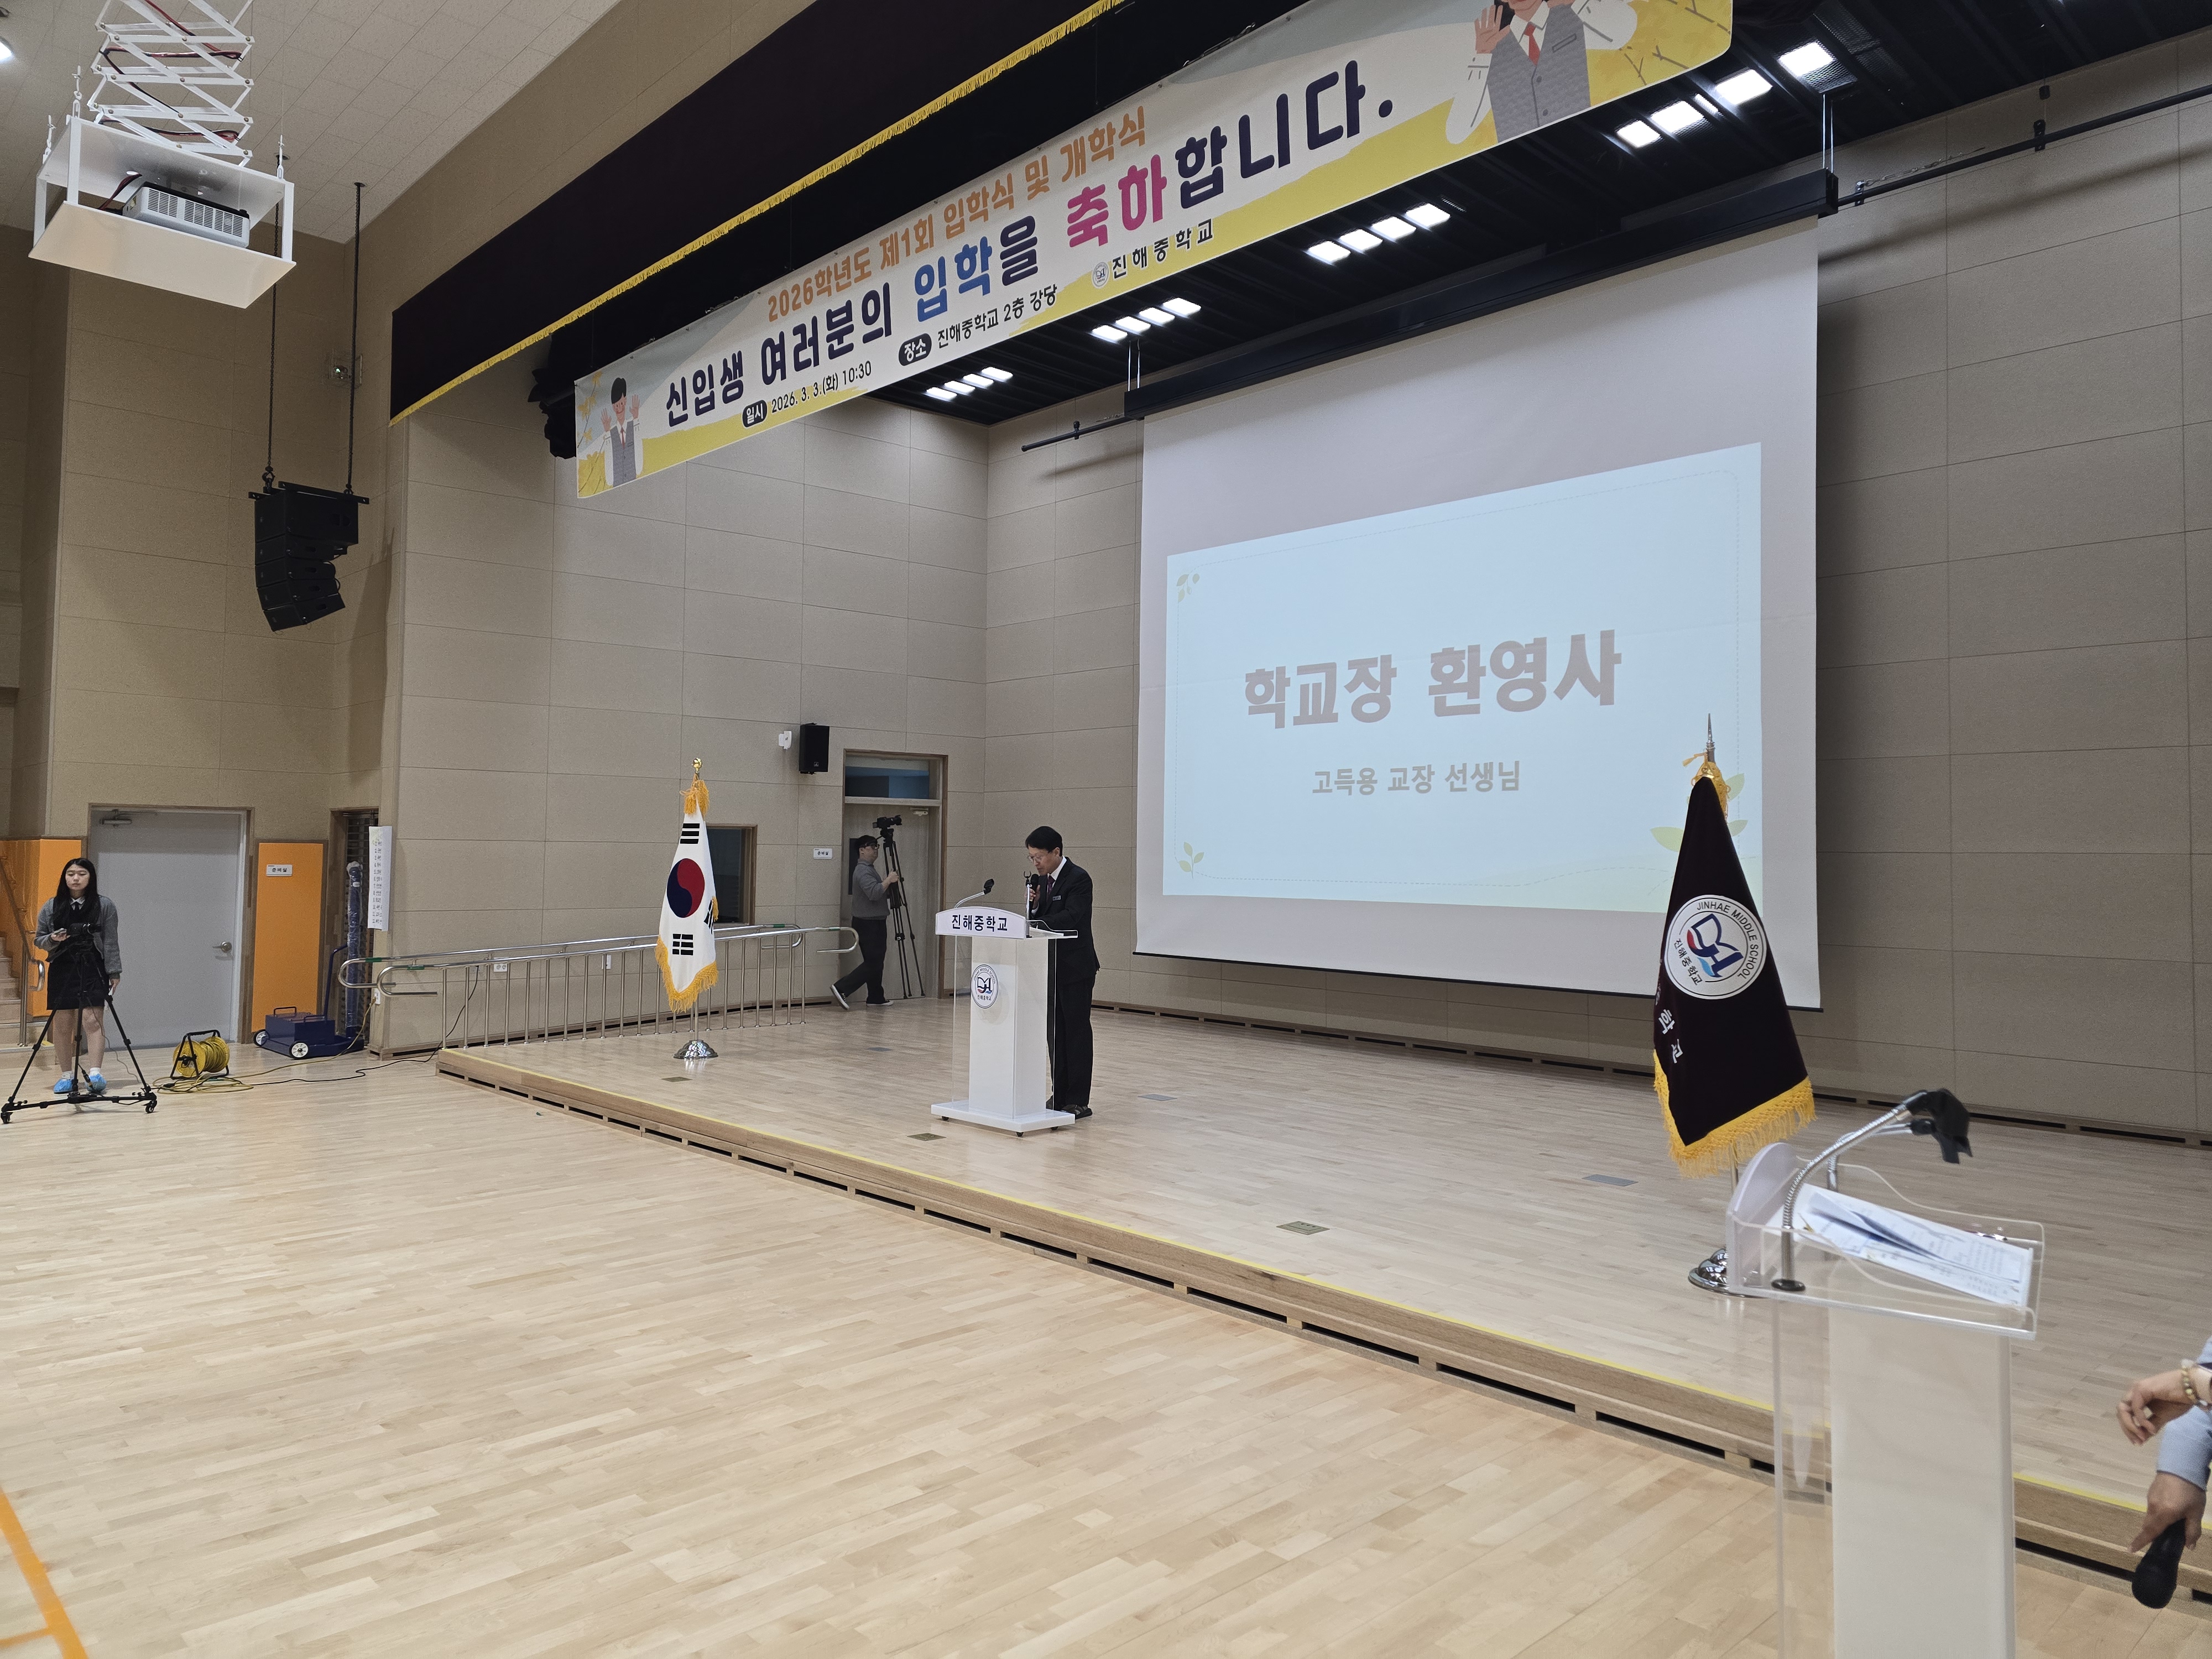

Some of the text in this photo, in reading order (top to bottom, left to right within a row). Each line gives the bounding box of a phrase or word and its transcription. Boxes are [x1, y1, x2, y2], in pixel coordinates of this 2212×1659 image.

[666, 60, 1393, 427] 신입생 여러분의 입학을 축하합니다.
[768, 106, 1145, 322] 2026학년도 제1회 입학식 및 개학식
[1112, 218, 1213, 279] 진해중학교
[904, 284, 1057, 362] 장소 진해중학교 2층 강당
[745, 405, 764, 425] 일시
[771, 394, 798, 414] 2026.
[801, 388, 810, 402] 3.
[842, 360, 872, 385] 10:30
[1244, 629, 1622, 729] 학교장 환영사
[1312, 760, 1520, 796] 고득용 교장 선생님
[952, 914, 1008, 932] 진해중학교
[1697, 901, 1759, 979] JINHAE MIDDLE SCHOOL
[1674, 938, 1703, 985] 진해중학교
